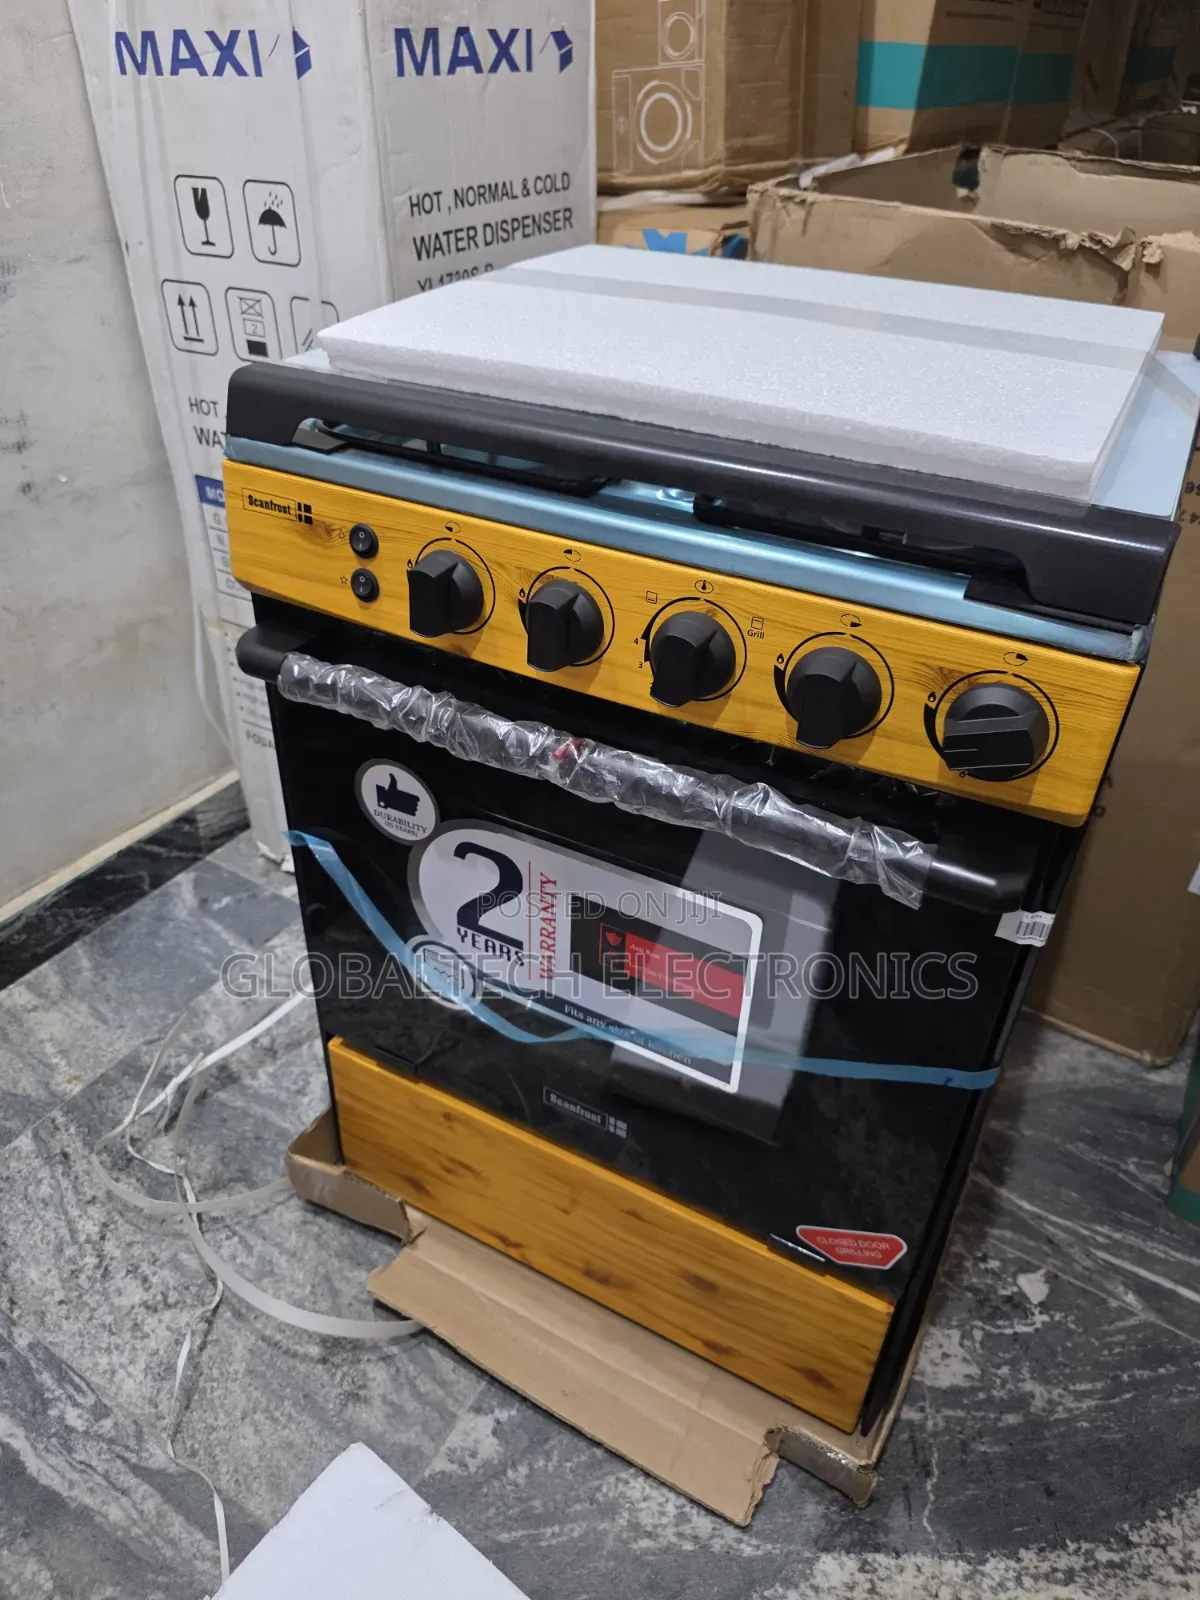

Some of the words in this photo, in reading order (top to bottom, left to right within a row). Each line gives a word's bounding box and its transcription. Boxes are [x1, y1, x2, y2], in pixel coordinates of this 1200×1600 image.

[115, 29, 264, 78] MAXI
[394, 27, 534, 78] MAXI
[453, 180, 518, 211] NORMAL
[521, 178, 530, 198] &
[533, 172, 571, 195] COLD
[412, 225, 480, 262] WATER
[483, 207, 574, 247] DISPENSER
[187, 396, 219, 417] HOT
[248, 494, 292, 516] Scanfrost
[634, 638, 639, 646] 4
[747, 630, 765, 640] Grill
[638, 660, 643, 669] 3
[374, 809, 427, 833] DURABILITY
[453, 841, 524, 950] 2
[539, 871, 558, 981] WARRANTY
[456, 927, 525, 967] YEARS
[564, 1004, 584, 1019] Fits
[586, 1015, 606, 1029] any
[550, 1092, 601, 1124] Scanfrost
[816, 1236, 857, 1248] CLOSED
[859, 1240, 890, 1250] DOOR
[835, 1246, 882, 1259] GRILLING
